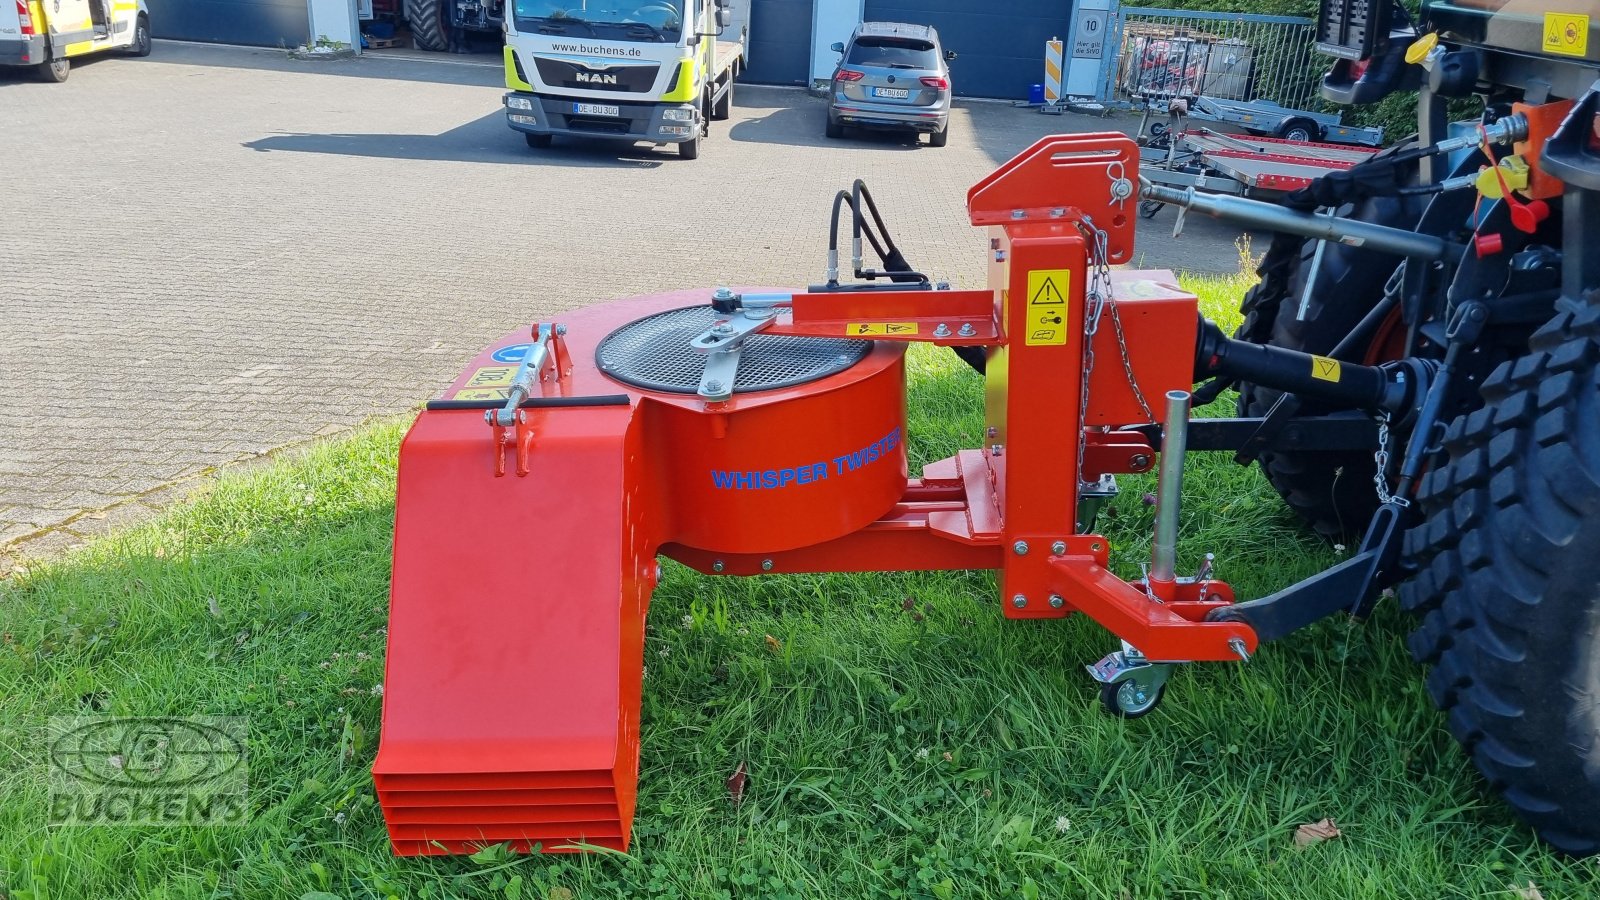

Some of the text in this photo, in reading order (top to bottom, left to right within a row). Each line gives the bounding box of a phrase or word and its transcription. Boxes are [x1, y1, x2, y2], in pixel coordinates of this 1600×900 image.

[1086, 20, 1097, 31] 10
[552, 43, 641, 56] www.buchens.de
[576, 72, 617, 84] MAN
[711, 426, 900, 489] WHISPER TWISTER
